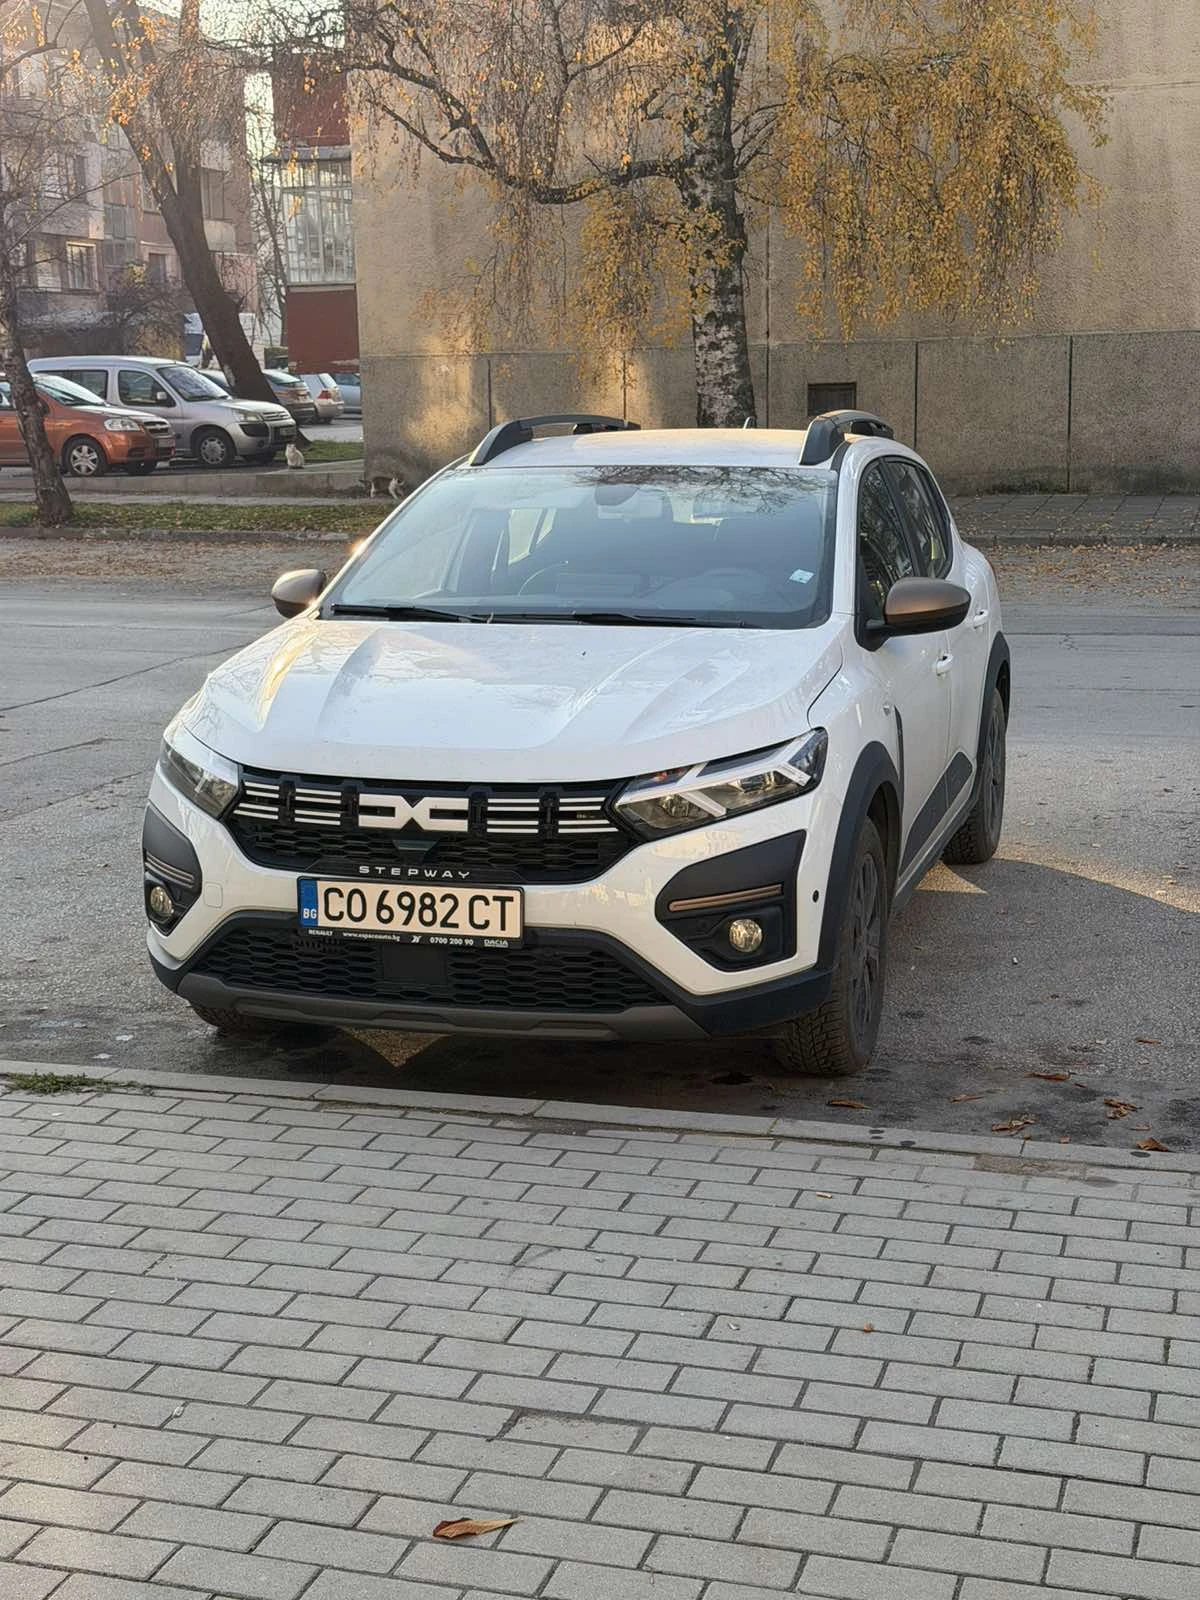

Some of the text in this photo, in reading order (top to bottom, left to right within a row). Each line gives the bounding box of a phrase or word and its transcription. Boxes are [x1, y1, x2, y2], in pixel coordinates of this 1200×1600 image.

[358, 865, 471, 879] STEPWAY
[302, 908, 318, 920] BG
[323, 887, 514, 931] CO 6982 CT
[308, 929, 333, 937] RENAULT
[429, 937, 448, 945] 0700
[484, 939, 509, 947] DACIA
